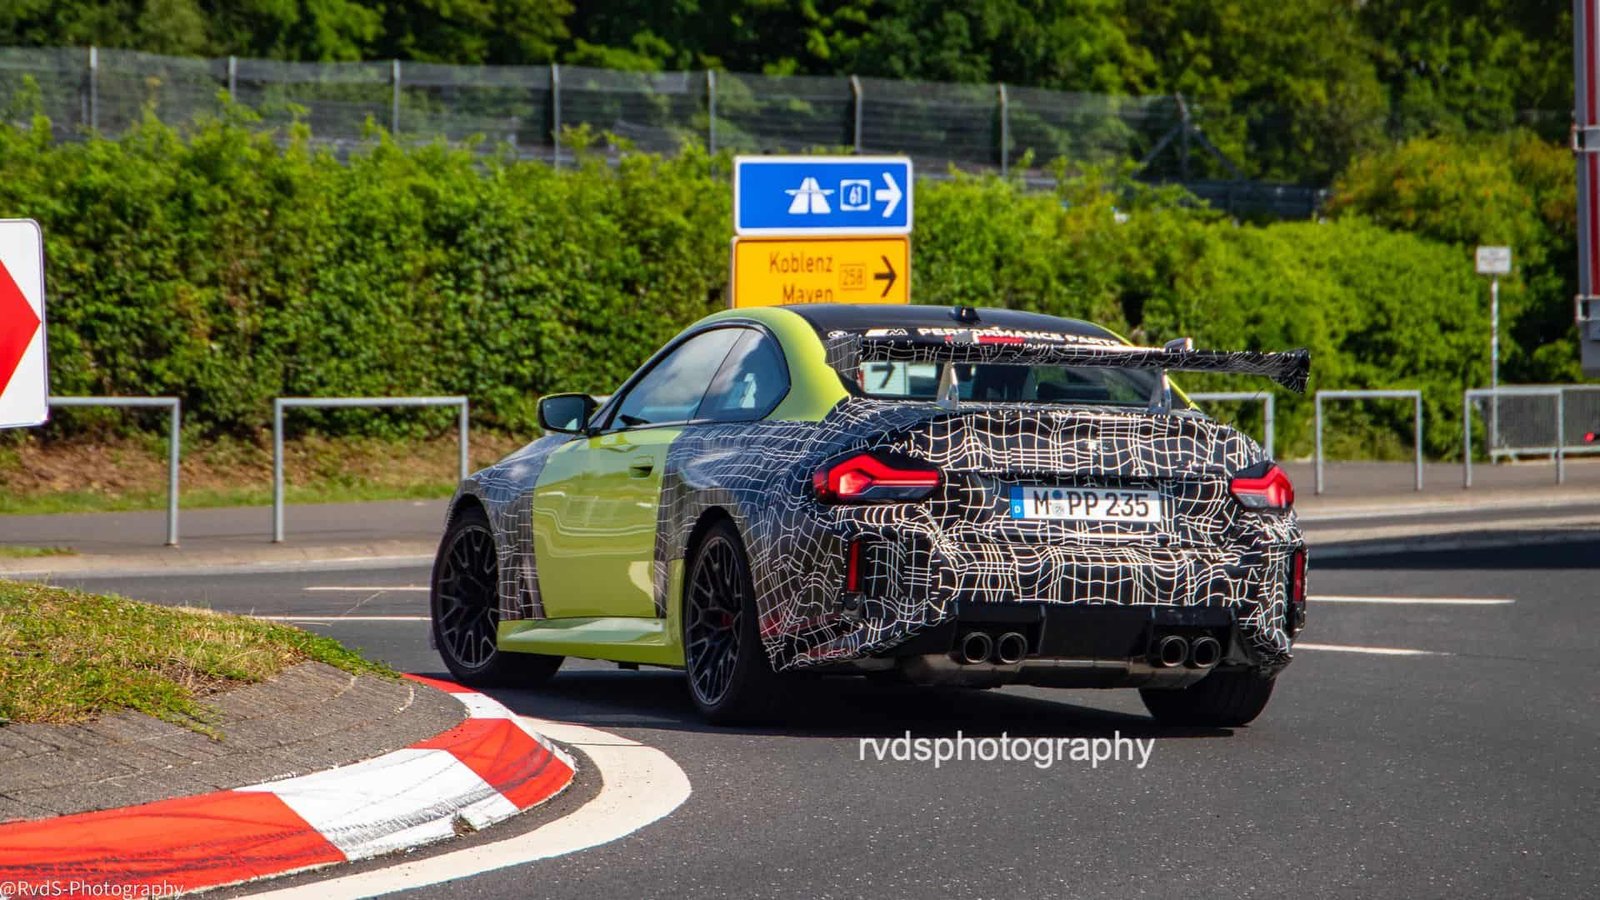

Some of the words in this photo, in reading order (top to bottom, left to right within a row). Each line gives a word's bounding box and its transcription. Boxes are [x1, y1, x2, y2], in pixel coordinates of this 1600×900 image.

[849, 185, 862, 205] 61
[769, 251, 834, 274] Koblenz
[842, 268, 863, 286] 258
[783, 284, 834, 304] Mayen
[1033, 491, 1050, 515] M
[1067, 491, 1099, 516] PP
[1105, 493, 1149, 517] 235
